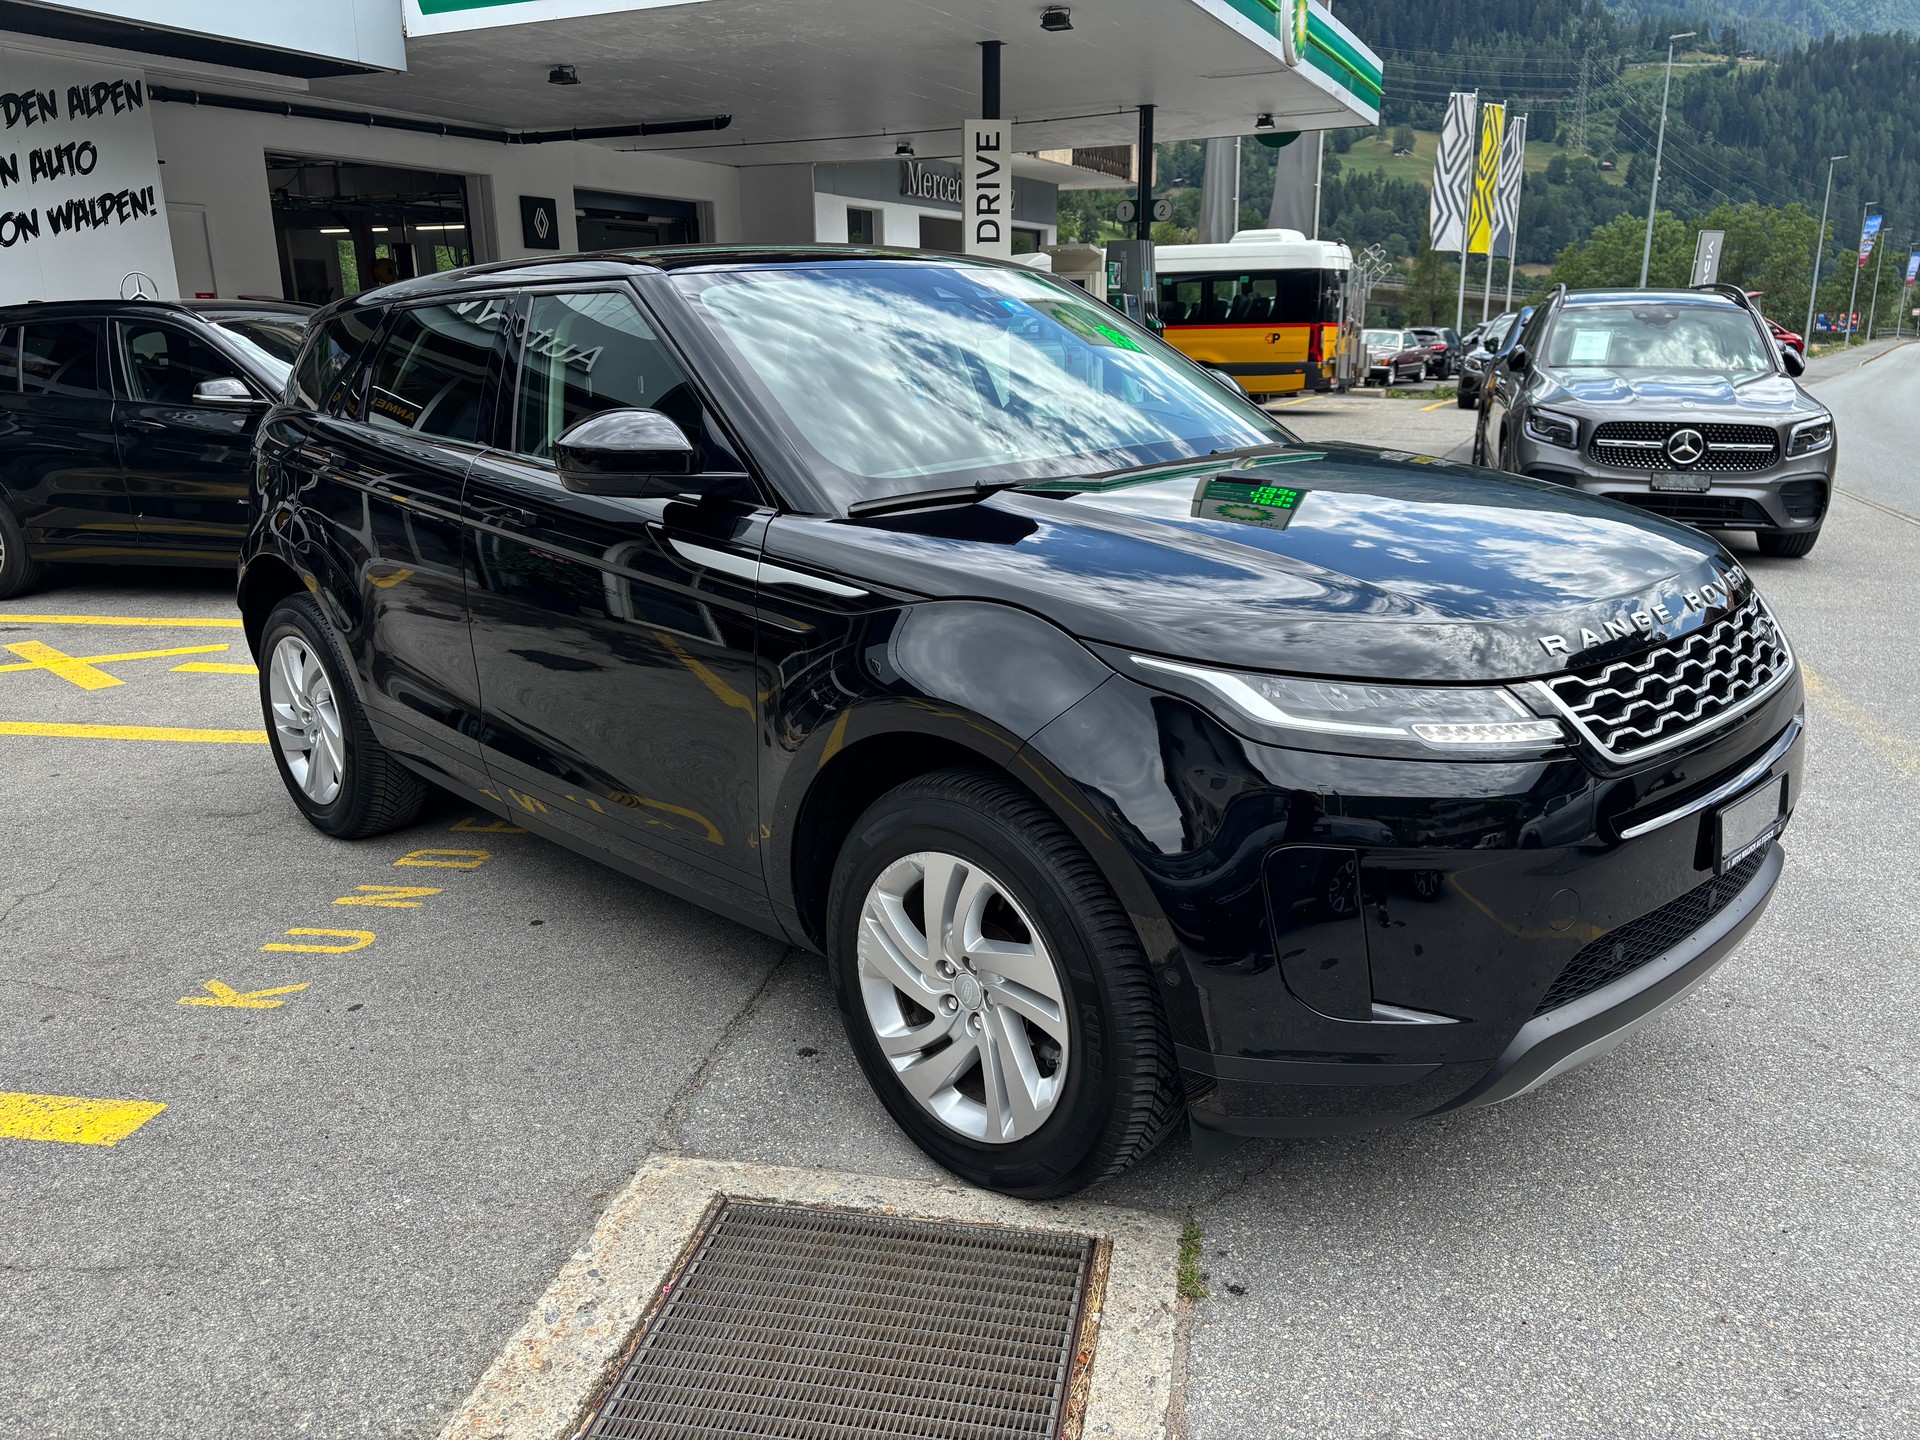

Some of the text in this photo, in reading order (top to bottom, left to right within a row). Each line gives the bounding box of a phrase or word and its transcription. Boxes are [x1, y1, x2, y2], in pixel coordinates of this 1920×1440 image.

[0, 79, 144, 129] DEN ALPEN
[29, 140, 98, 185] AUTO
[976, 131, 1001, 244] DRIVE
[46, 186, 158, 238] WALPEN!
[1122, 205, 1127, 217] 1
[1159, 204, 1166, 217] 2
[1538, 564, 1749, 657] RANGE ROVER
